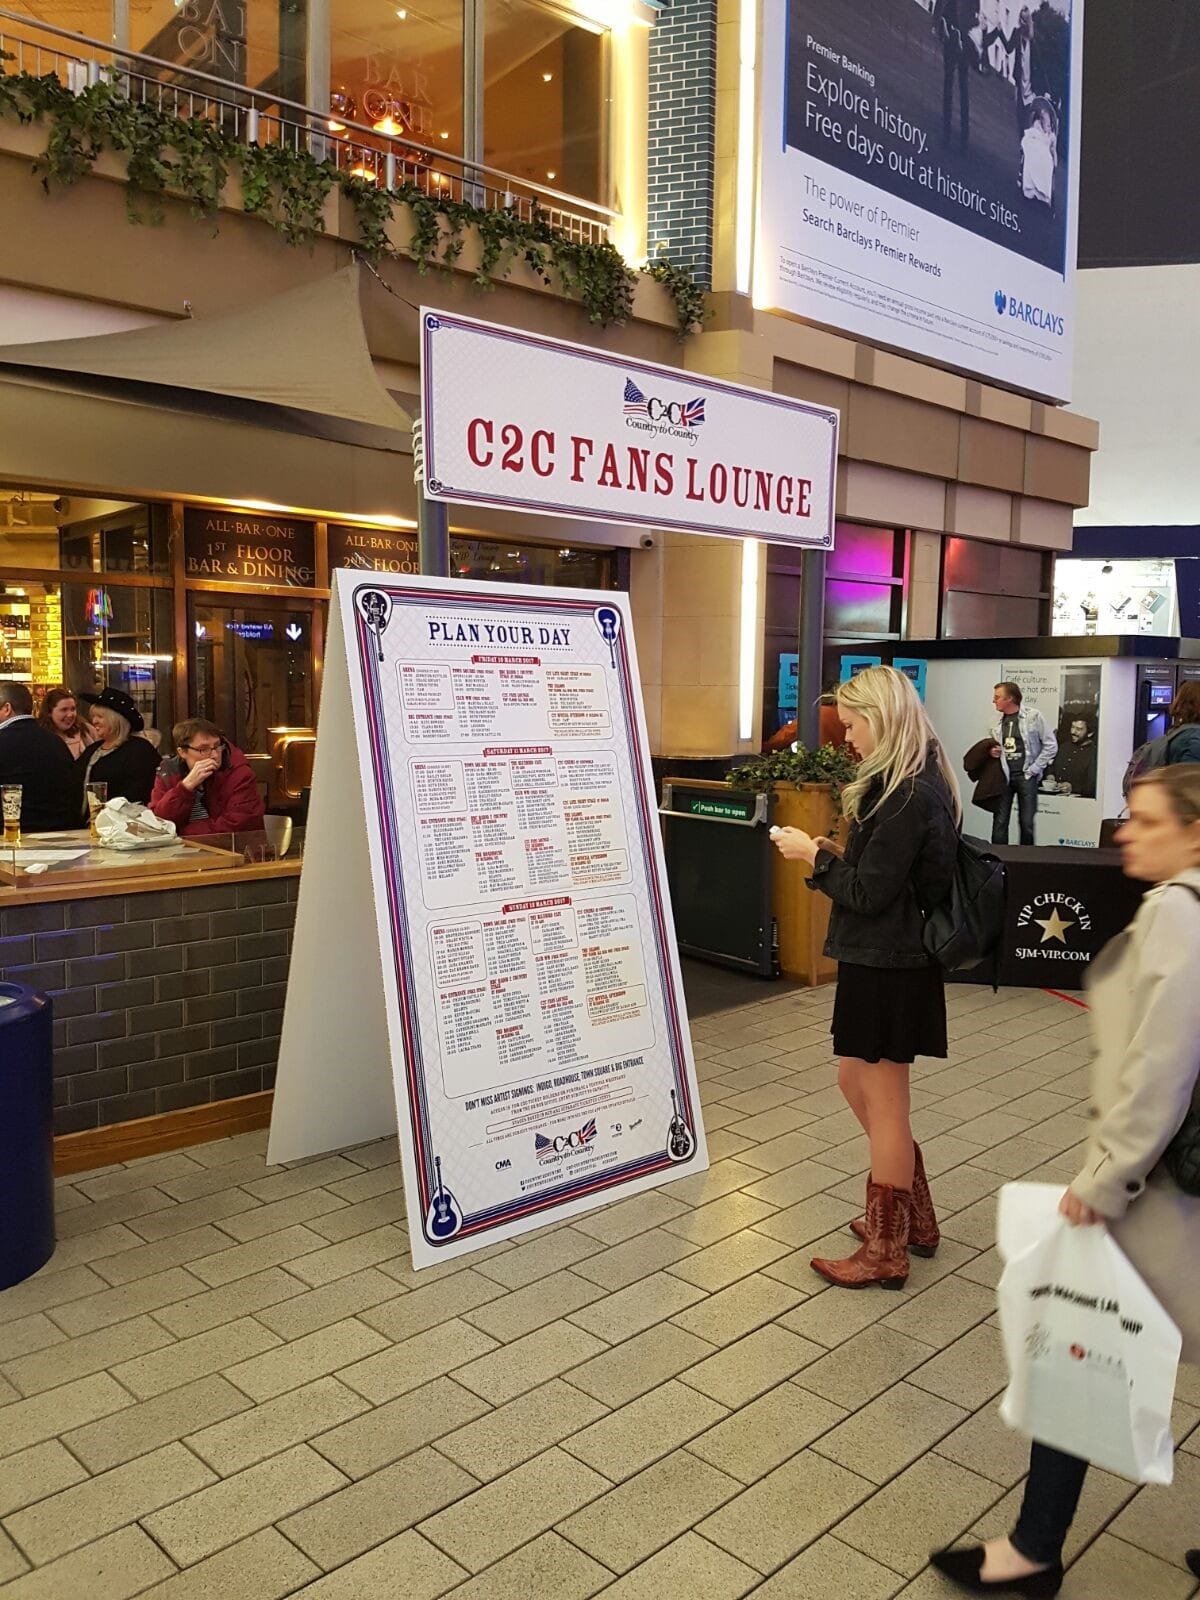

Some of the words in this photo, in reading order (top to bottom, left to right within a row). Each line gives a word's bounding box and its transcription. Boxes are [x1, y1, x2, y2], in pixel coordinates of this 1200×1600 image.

[807, 35, 841, 64] Premier
[842, 56, 876, 88] Banking
[806, 62, 870, 119] Explore
[874, 97, 929, 154] history.
[805, 101, 843, 143] Free
[847, 124, 885, 165] days
[889, 150, 916, 181] out
[919, 164, 934, 190] at
[937, 167, 987, 216] historic
[990, 200, 1022, 234] sites.
[803, 175, 827, 201] The
[830, 191, 865, 217] power
[867, 206, 879, 223] of
[881, 210, 920, 242] Premier
[802, 208, 835, 234] Search
[837, 222, 873, 250] Barclays
[875, 238, 908, 264] Premier
[909, 253, 942, 278] Rewards
[1008, 297, 1065, 336] BARCLAYS
[626, 417, 659, 439] Country
[668, 425, 700, 447] Country
[466, 417, 556, 479] C2C
[570, 435, 675, 496] FANS
[686, 458, 813, 518] LOUNGE
[237, 544, 295, 563] FLOOR
[374, 558, 421, 574] FLOOR
[188, 557, 222, 574] BAR
[227, 563, 238, 575] &
[244, 561, 311, 582] DINING
[428, 621, 480, 642] PLAN
[484, 624, 534, 645] YOUR
[539, 627, 571, 646] DAY
[1026, 685, 1039, 693] hot
[701, 804, 714, 813] Push
[714, 805, 723, 814] bar
[725, 807, 730, 815] to
[731, 809, 746, 817] open
[1065, 839, 1096, 848] BARCLAYS
[535, 899, 553, 908] MARCH
[1017, 904, 1034, 927] VIP
[1033, 893, 1086, 914] CHECK
[1079, 913, 1092, 931] IN
[1015, 947, 1091, 962] SJM-VIP.COM
[464, 1098, 480, 1111] DON'T
[480, 1094, 493, 1107] MISS
[493, 1090, 510, 1103] ARTIST
[581, 1068, 594, 1080] TOWN
[594, 1064, 610, 1076] SQUARE
[610, 1063, 614, 1072] &
[614, 1061, 622, 1071] BIG
[623, 1055, 644, 1069] ENTRANCE
[495, 1159, 512, 1170] CMA
[538, 1152, 564, 1167] Country
[571, 1144, 595, 1157] Country
